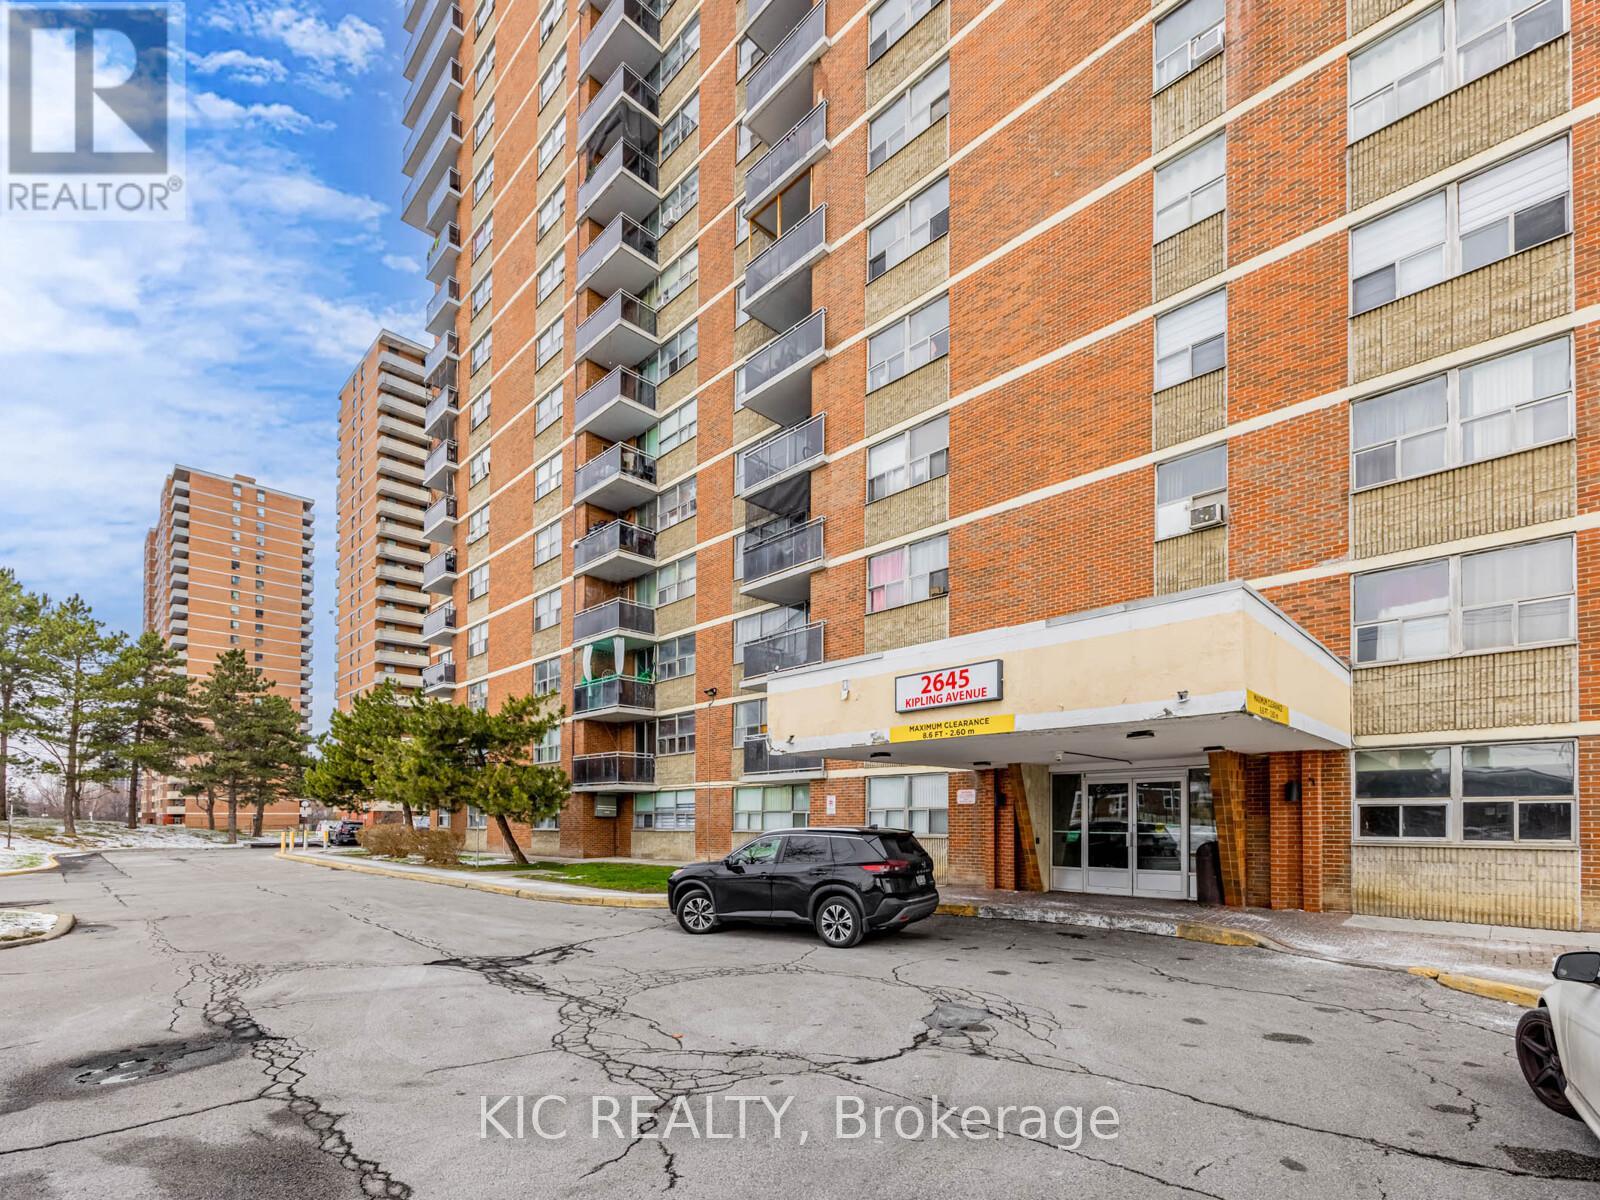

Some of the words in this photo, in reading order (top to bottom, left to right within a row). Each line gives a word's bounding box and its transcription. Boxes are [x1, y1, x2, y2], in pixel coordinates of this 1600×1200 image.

[920, 668, 971, 694] 2645
[905, 693, 944, 709] KIPLING
[945, 686, 988, 703] AVENUE
[909, 721, 943, 733] MAXIMUM
[944, 717, 990, 729] CLEARANCE
[922, 731, 933, 739] 8.6
[934, 730, 943, 738] FT
[949, 728, 966, 736] 2.60
